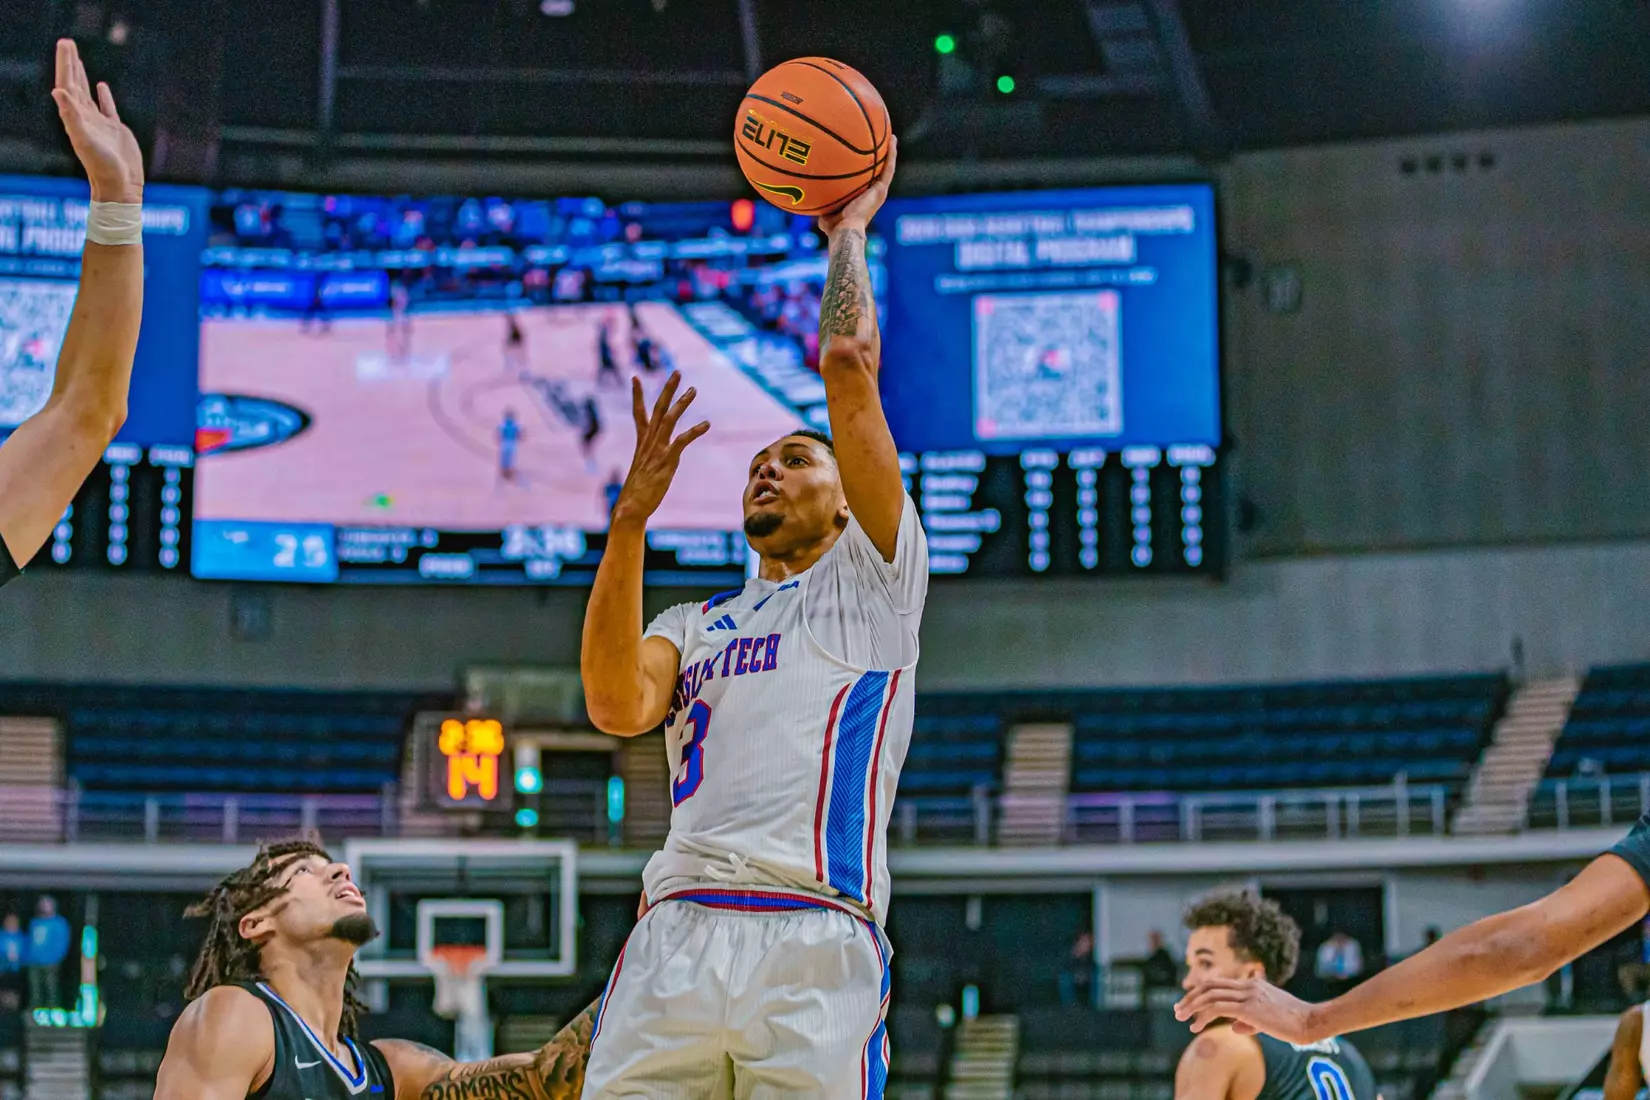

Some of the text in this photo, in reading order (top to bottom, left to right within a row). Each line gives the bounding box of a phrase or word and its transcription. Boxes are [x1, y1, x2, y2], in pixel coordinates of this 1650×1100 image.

[741, 115, 812, 166] ELITE
[720, 633, 782, 678] TECH
[447, 752, 499, 801] 14
[672, 698, 713, 808] 3
